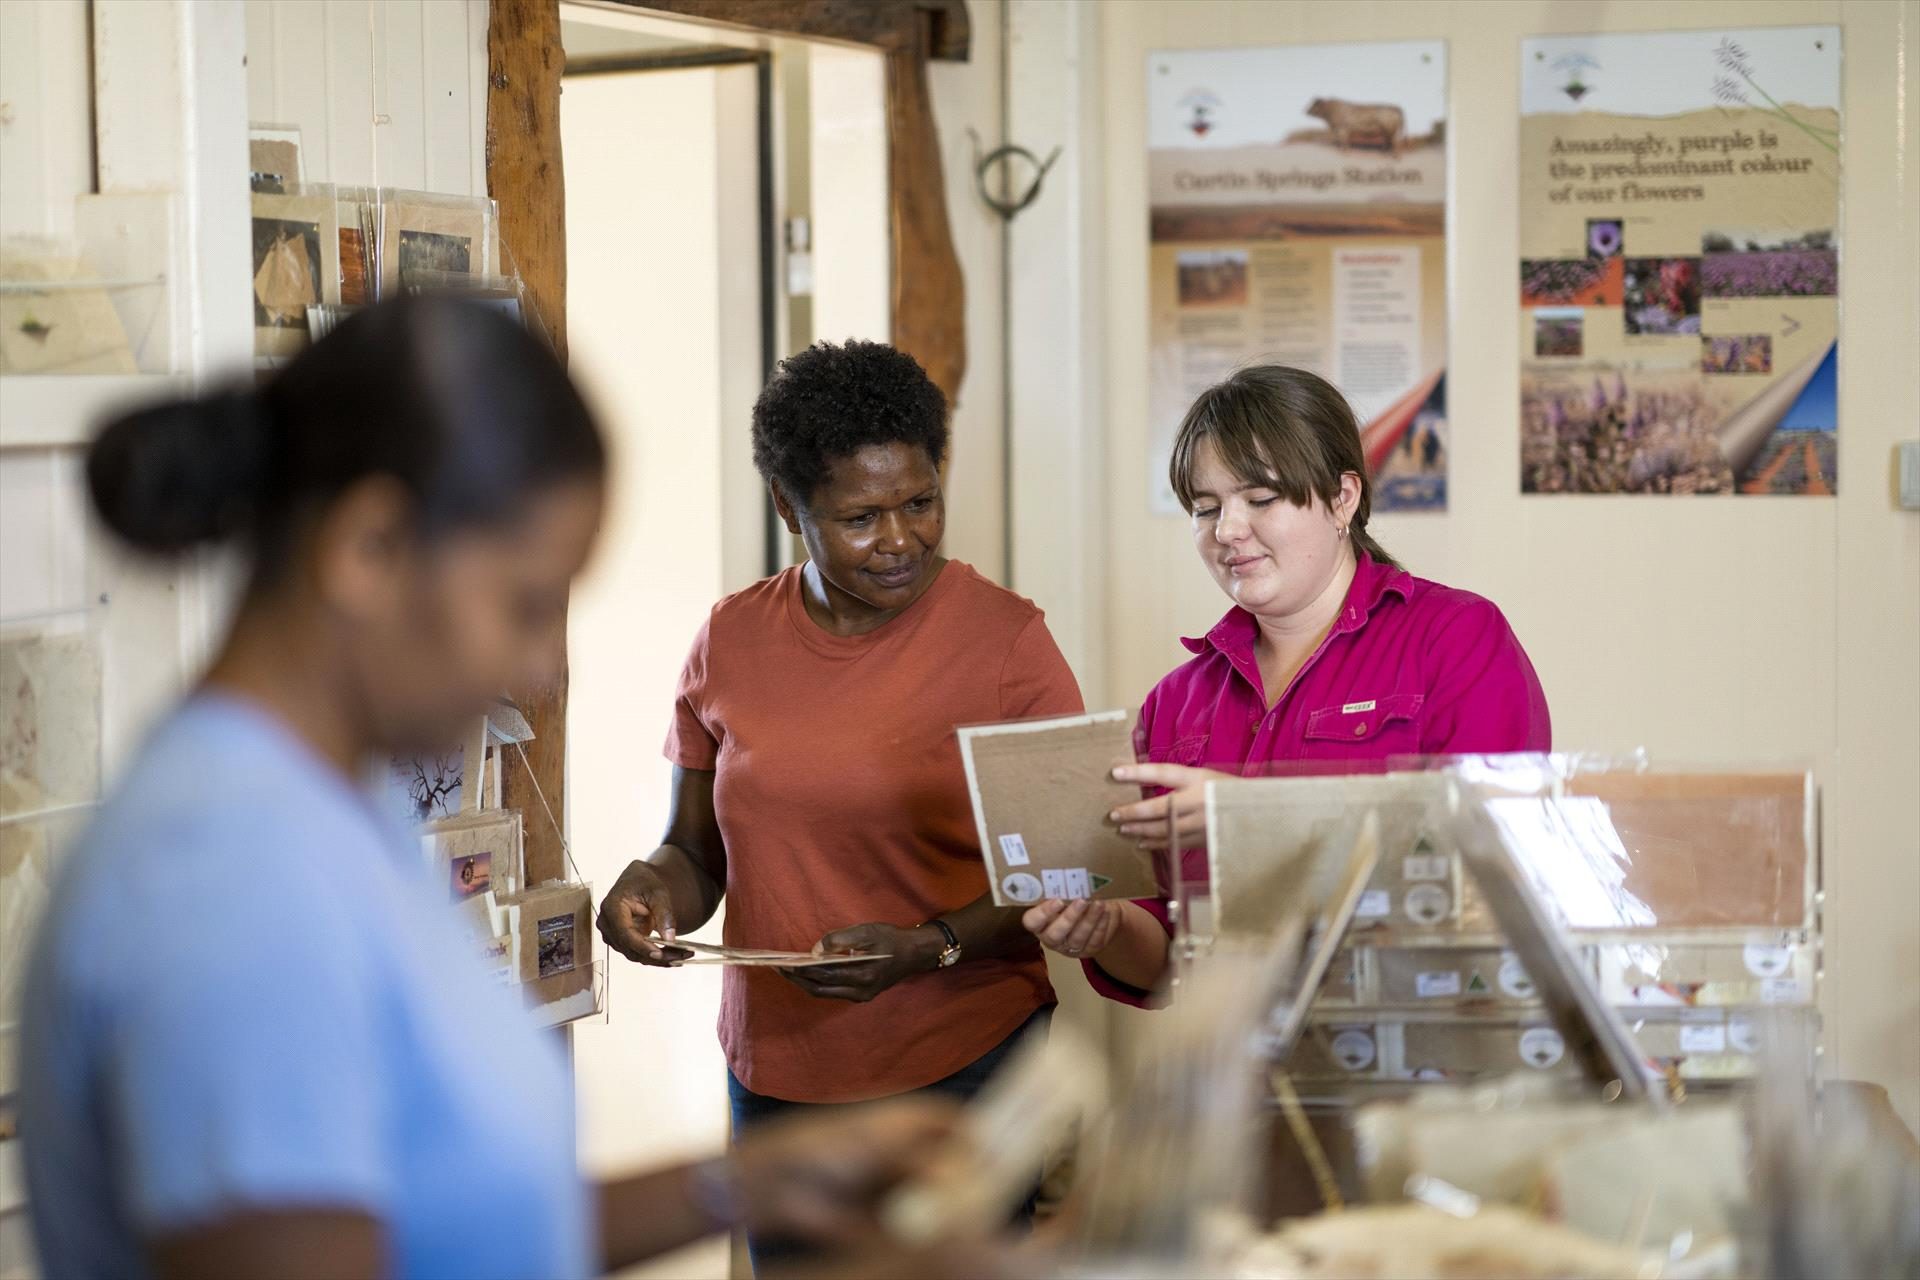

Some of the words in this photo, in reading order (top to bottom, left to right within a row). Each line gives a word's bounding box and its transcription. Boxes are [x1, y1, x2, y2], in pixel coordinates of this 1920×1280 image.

[1551, 131, 1673, 157] Amazingly,
[1679, 129, 1754, 155] purple
[1757, 129, 1778, 147] is
[1255, 164, 1338, 192] Springs
[1344, 163, 1423, 184] Station
[1549, 157, 1585, 178] the
[1591, 153, 1735, 180] predominant
[1741, 152, 1813, 173] colour
[1549, 183, 1573, 201] of
[1577, 187, 1616, 201] our
[1621, 181, 1704, 201] flowers
